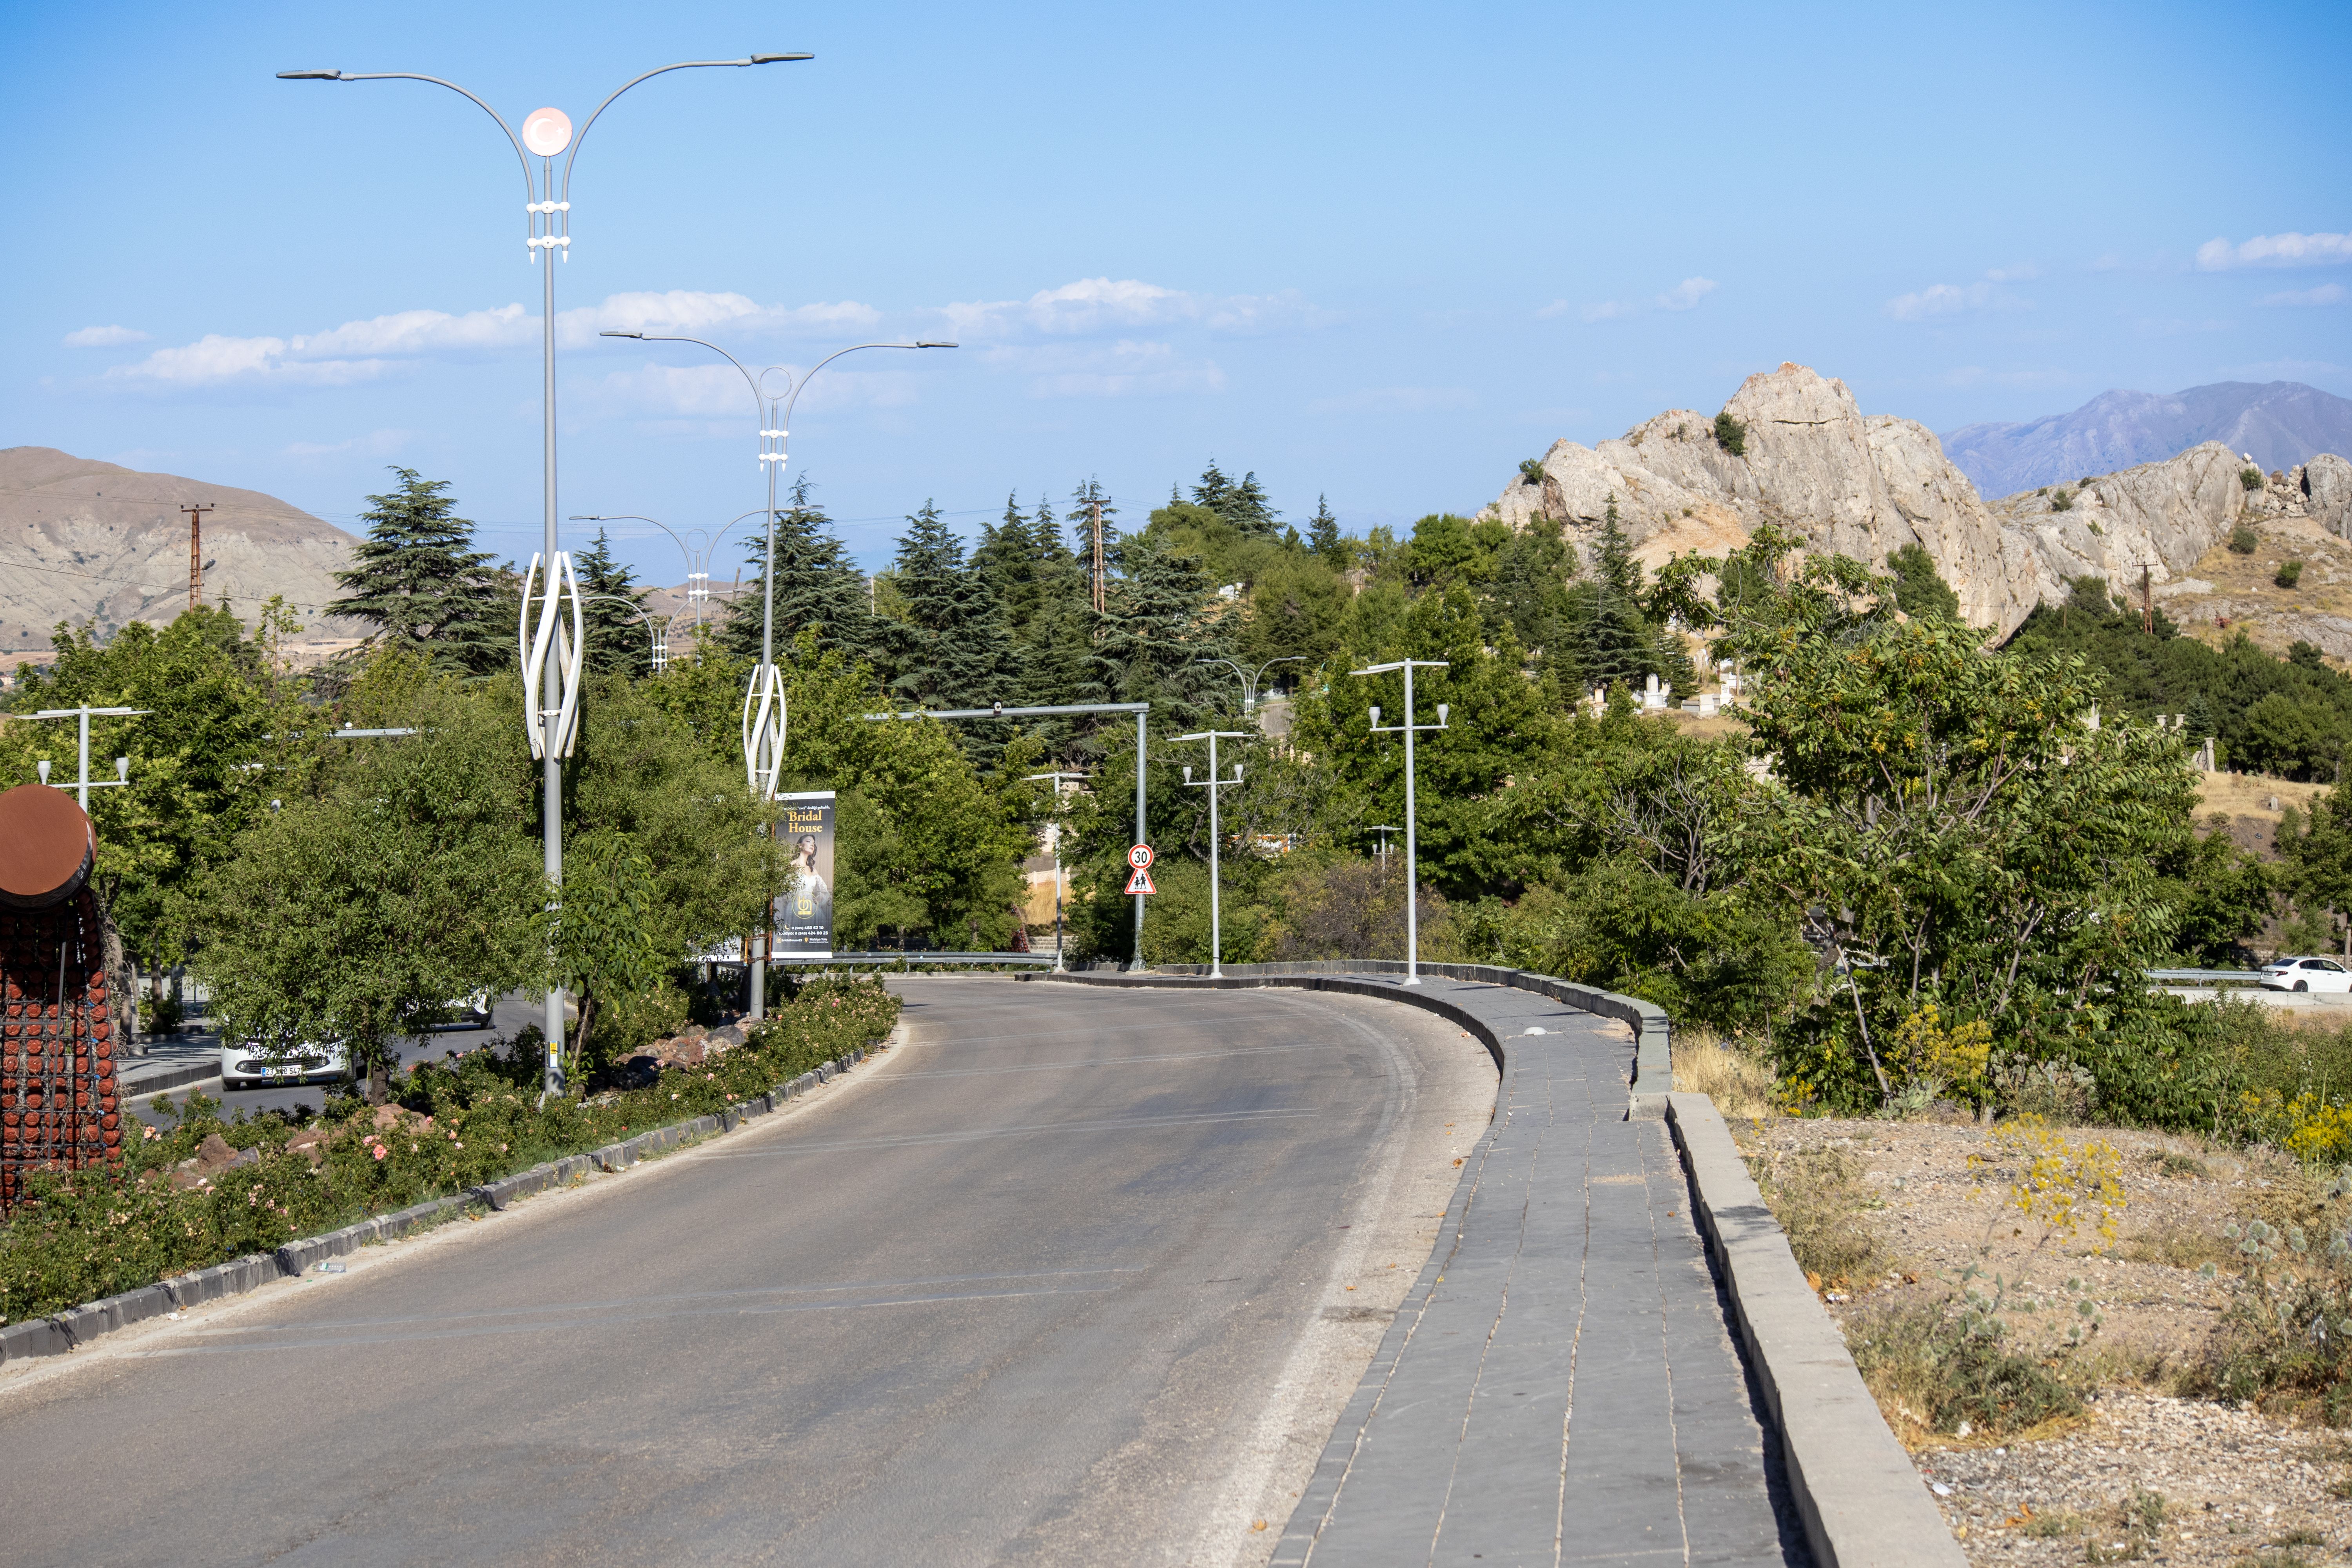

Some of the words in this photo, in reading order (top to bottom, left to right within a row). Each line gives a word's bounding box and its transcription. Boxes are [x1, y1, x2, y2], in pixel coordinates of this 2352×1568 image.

[789, 810, 822, 821] Bridal
[789, 822, 822, 833] House
[1135, 851, 1147, 863] 30
